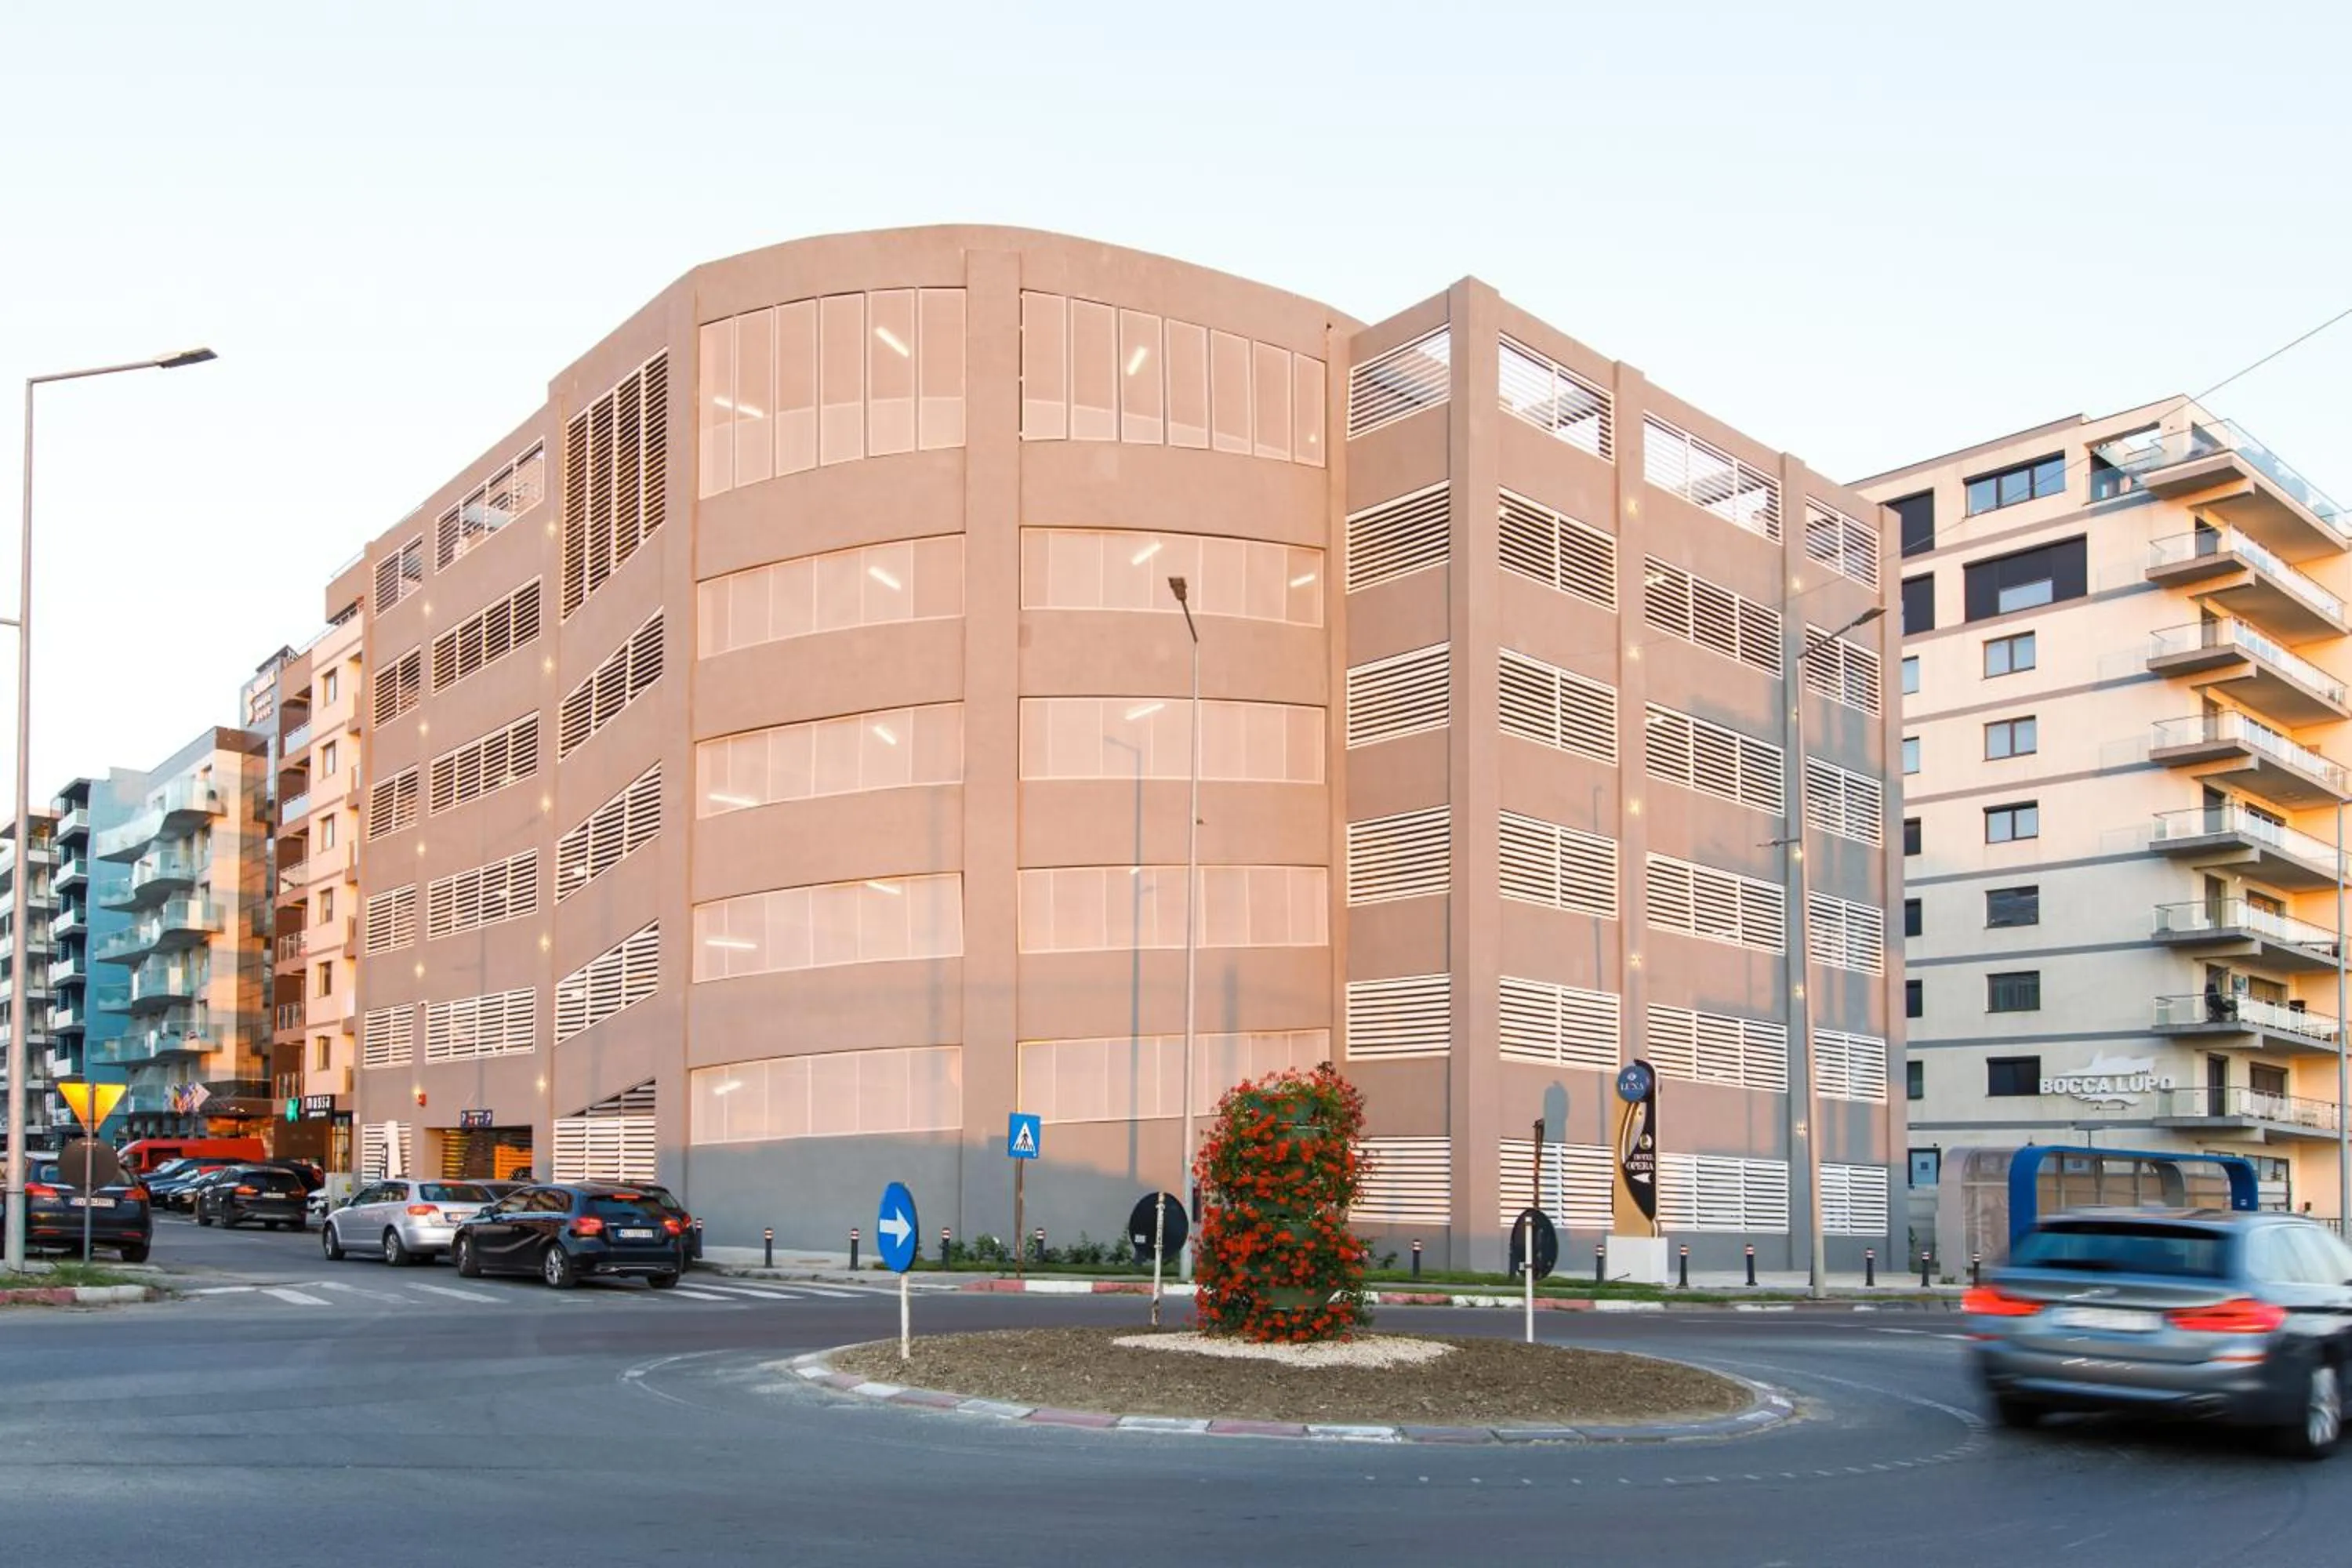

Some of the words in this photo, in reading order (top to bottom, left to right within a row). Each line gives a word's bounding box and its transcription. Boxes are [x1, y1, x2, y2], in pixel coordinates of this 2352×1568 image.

[2039, 1077, 2112, 1094] BOCCA
[2117, 1075, 2176, 1093] LUPO
[1625, 1161, 1654, 1171] OPERA
